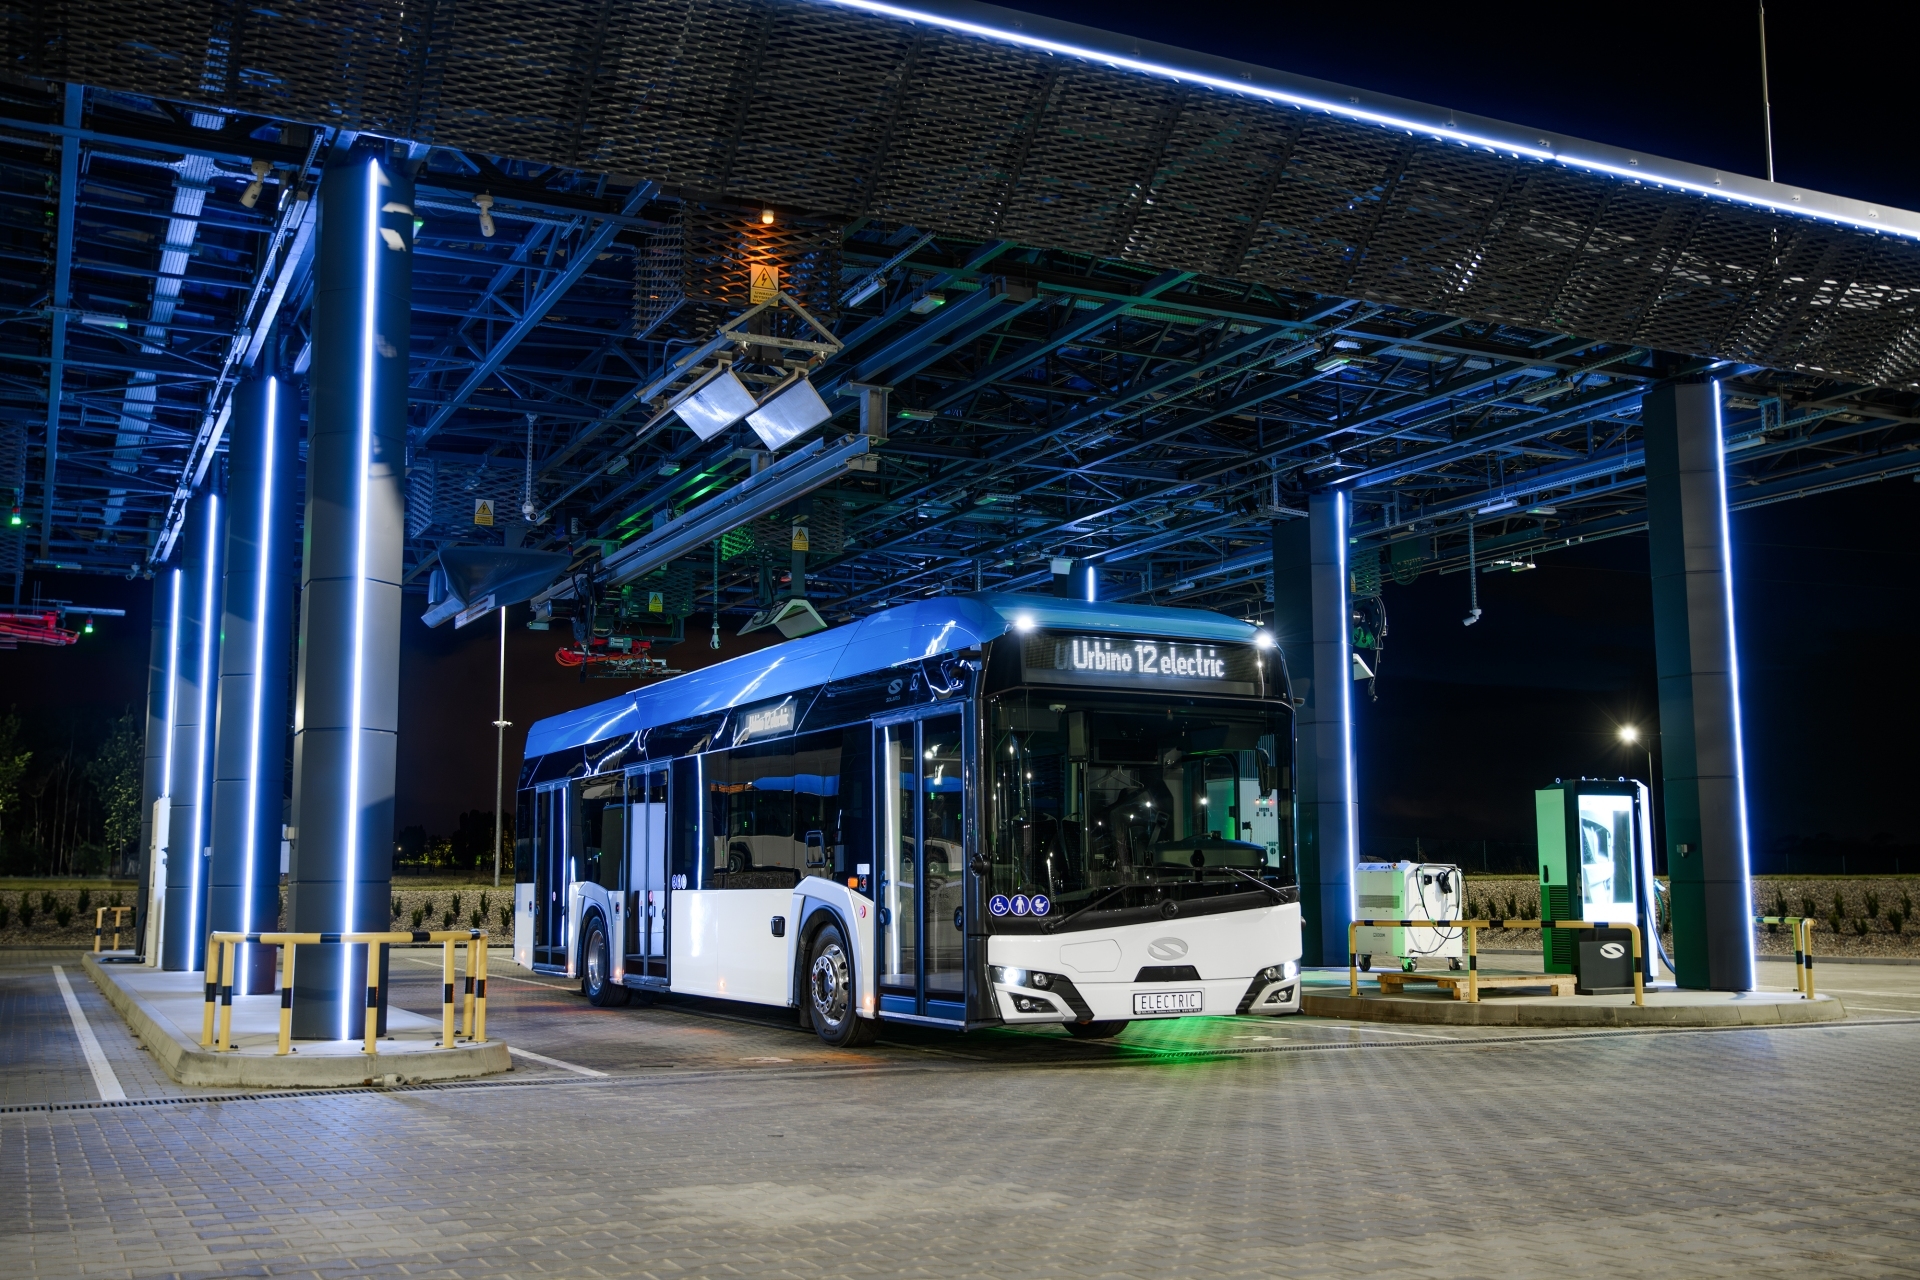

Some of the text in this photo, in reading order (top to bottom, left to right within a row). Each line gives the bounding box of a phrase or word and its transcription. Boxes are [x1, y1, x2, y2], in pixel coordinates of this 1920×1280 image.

[1072, 639, 1225, 678] Urbino 12 electric
[1141, 993, 1195, 1010] ELECTRIC
